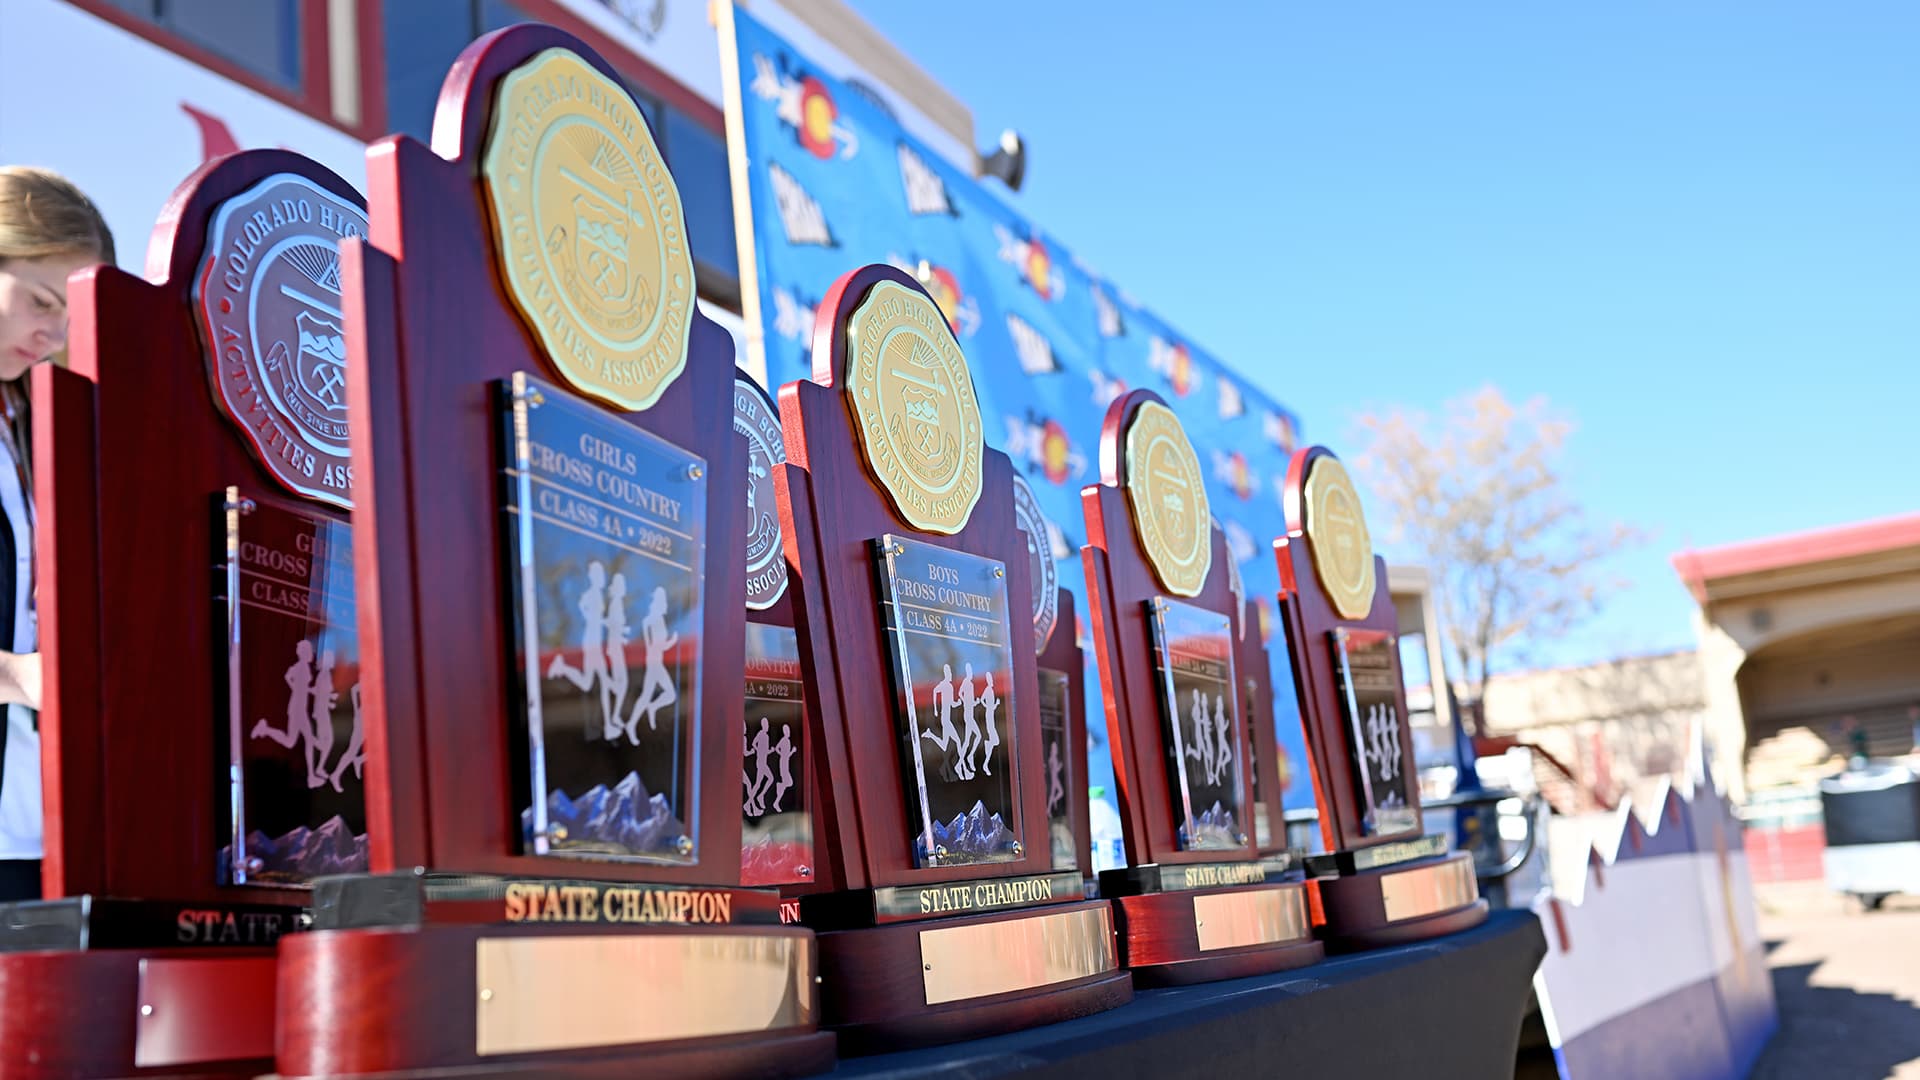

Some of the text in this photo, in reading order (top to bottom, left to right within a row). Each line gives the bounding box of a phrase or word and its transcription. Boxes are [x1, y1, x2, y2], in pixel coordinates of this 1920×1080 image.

[510, 74, 586, 172] COLORADO
[590, 82, 637, 145] HIGH
[636, 142, 681, 262] SCHOOL
[223, 199, 367, 294] COLORADO HIG
[509, 201, 596, 373] ACTIVITIES
[599, 290, 685, 387] ASSOCIATION
[860, 297, 902, 383] COLORADO
[902, 298, 936, 331] HIGH
[936, 331, 973, 411] SCHOOL
[222, 324, 316, 478] ACTIVITIES
[305, 411, 331, 433] SINE
[758, 416, 786, 464] SCHO
[579, 432, 638, 476] GIRLS
[864, 406, 978, 520] ACTIVITIES ASSOCIATION
[528, 440, 682, 523] CROSS COUNTRY
[538, 489, 674, 556] CLASS 4A 2022
[240, 541, 308, 578] CROSS
[927, 563, 960, 586] BOYS
[251, 580, 310, 613] CLASS
[896, 577, 992, 613] CROSS COUNTRY
[906, 610, 989, 639] CLASS 4A 2022
[745, 656, 796, 675] OUNTRY
[766, 683, 790, 697] 2022
[1185, 864, 1265, 887] STATE CHAMPION
[505, 883, 732, 924] STATE CHAMPION
[920, 879, 1052, 914] STATE CHAMPION
[176, 908, 284, 944] STATE
